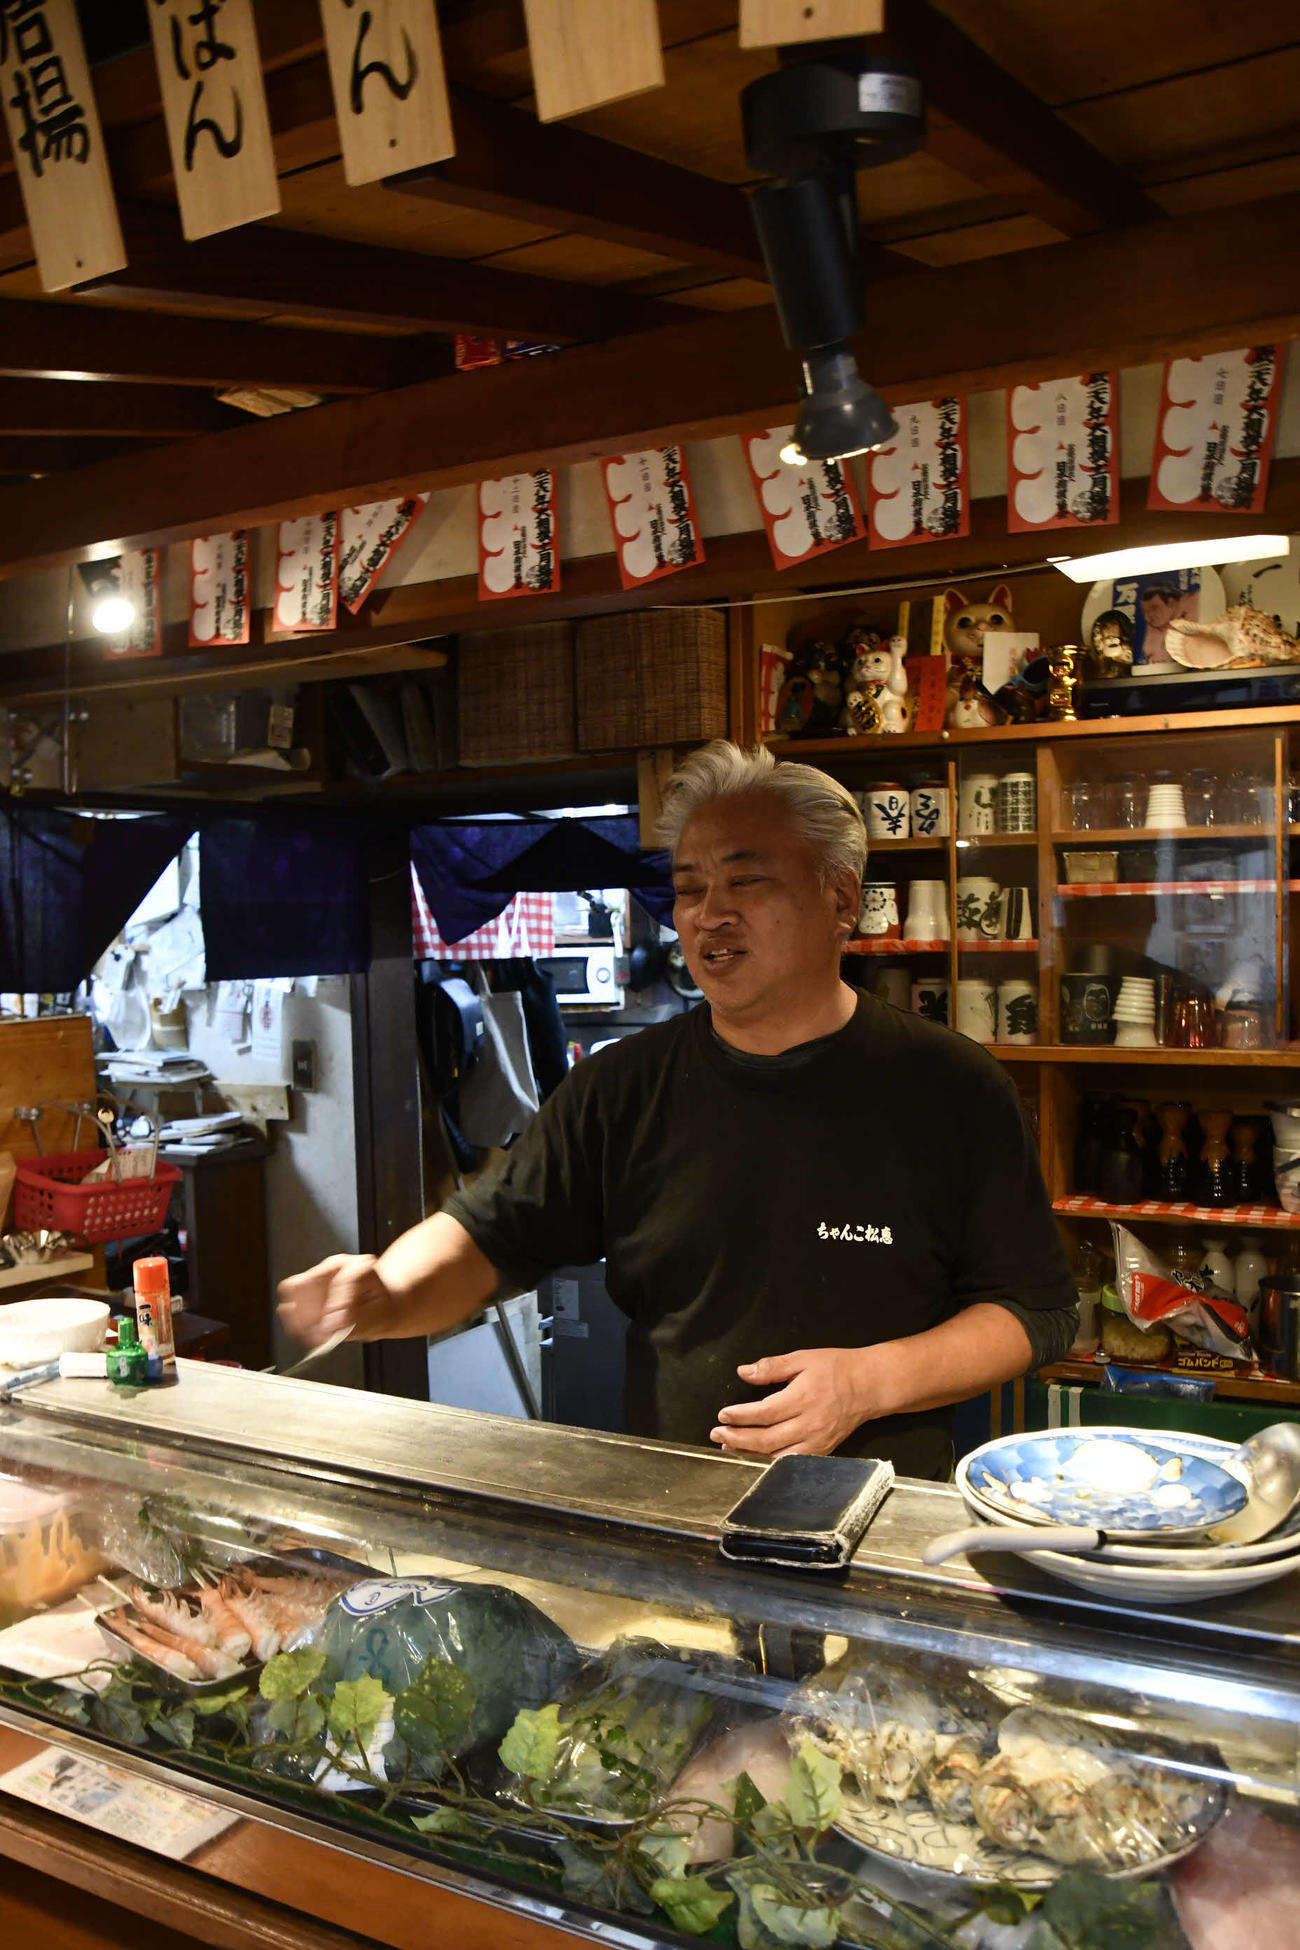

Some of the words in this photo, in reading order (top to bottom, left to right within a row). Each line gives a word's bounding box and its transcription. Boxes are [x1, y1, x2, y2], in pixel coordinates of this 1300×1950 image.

[1177, 1356, 1220, 1369] ゴムバンド
